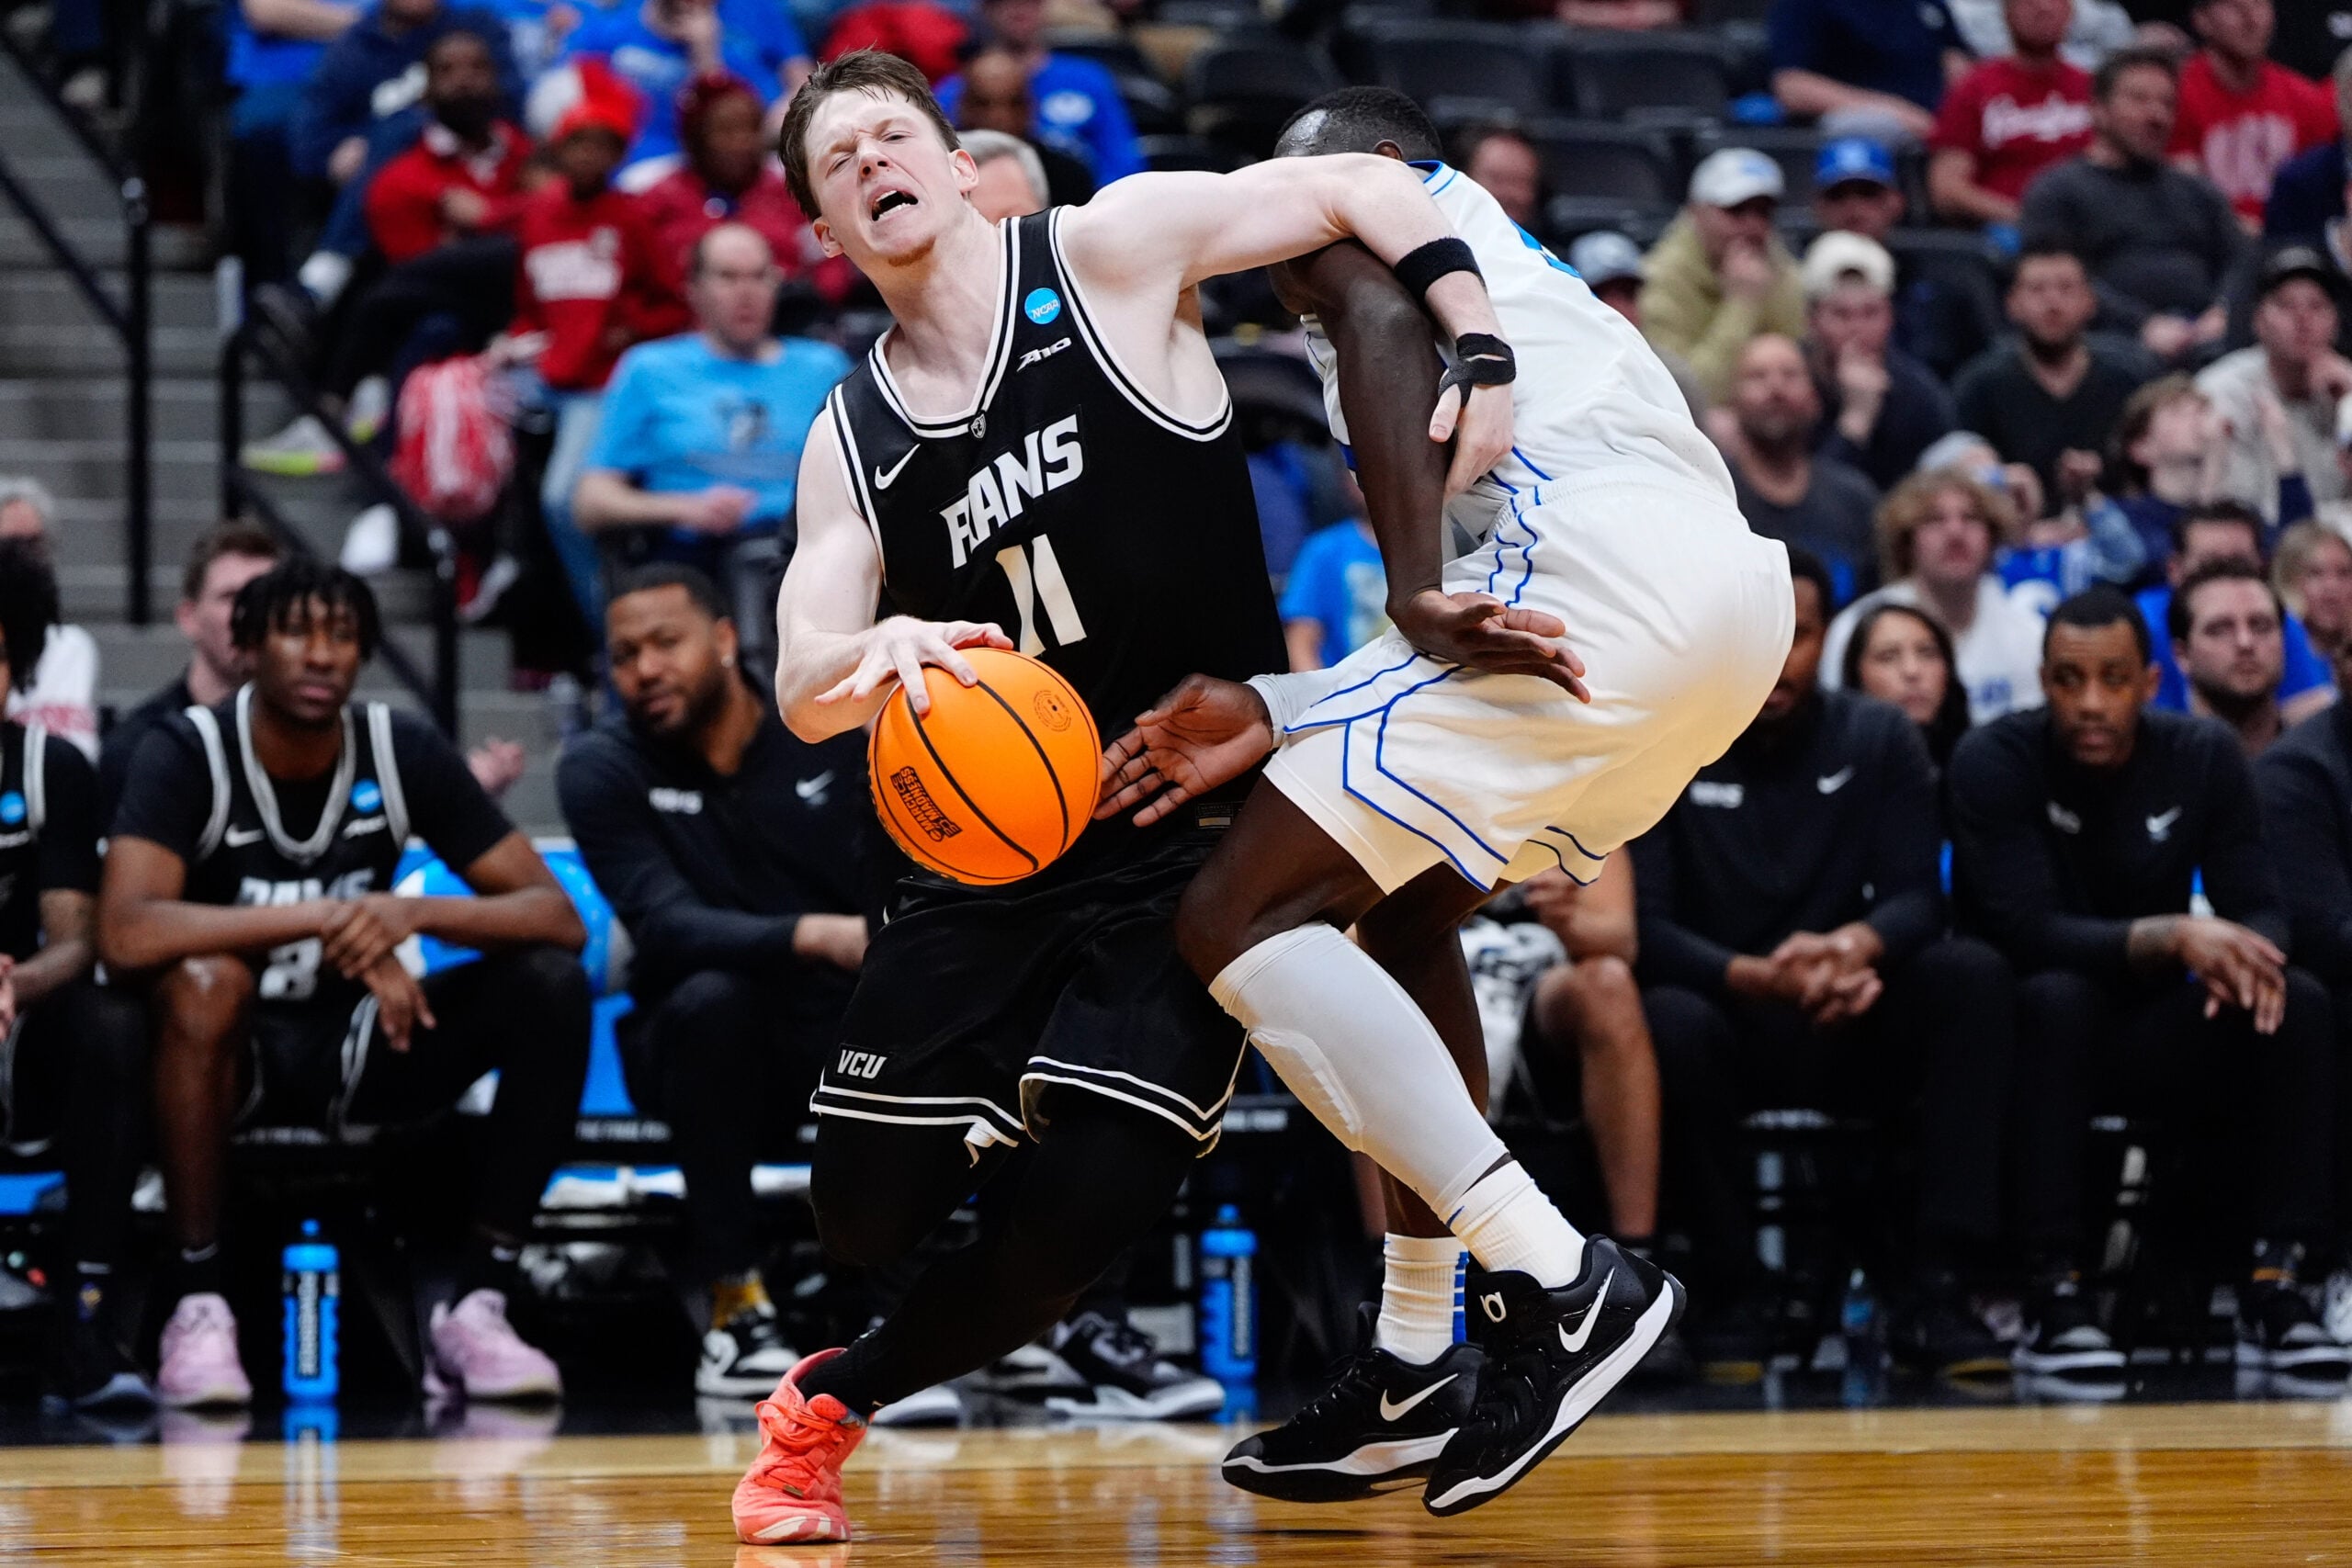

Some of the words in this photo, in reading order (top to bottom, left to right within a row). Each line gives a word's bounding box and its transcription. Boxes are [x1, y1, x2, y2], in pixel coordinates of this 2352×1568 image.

[1031, 299, 1060, 320] NCAA
[994, 533, 1088, 659] 11
[899, 767, 941, 821] MADNESS
[901, 792, 936, 832] MARCH
[837, 1049, 888, 1079] VCU
